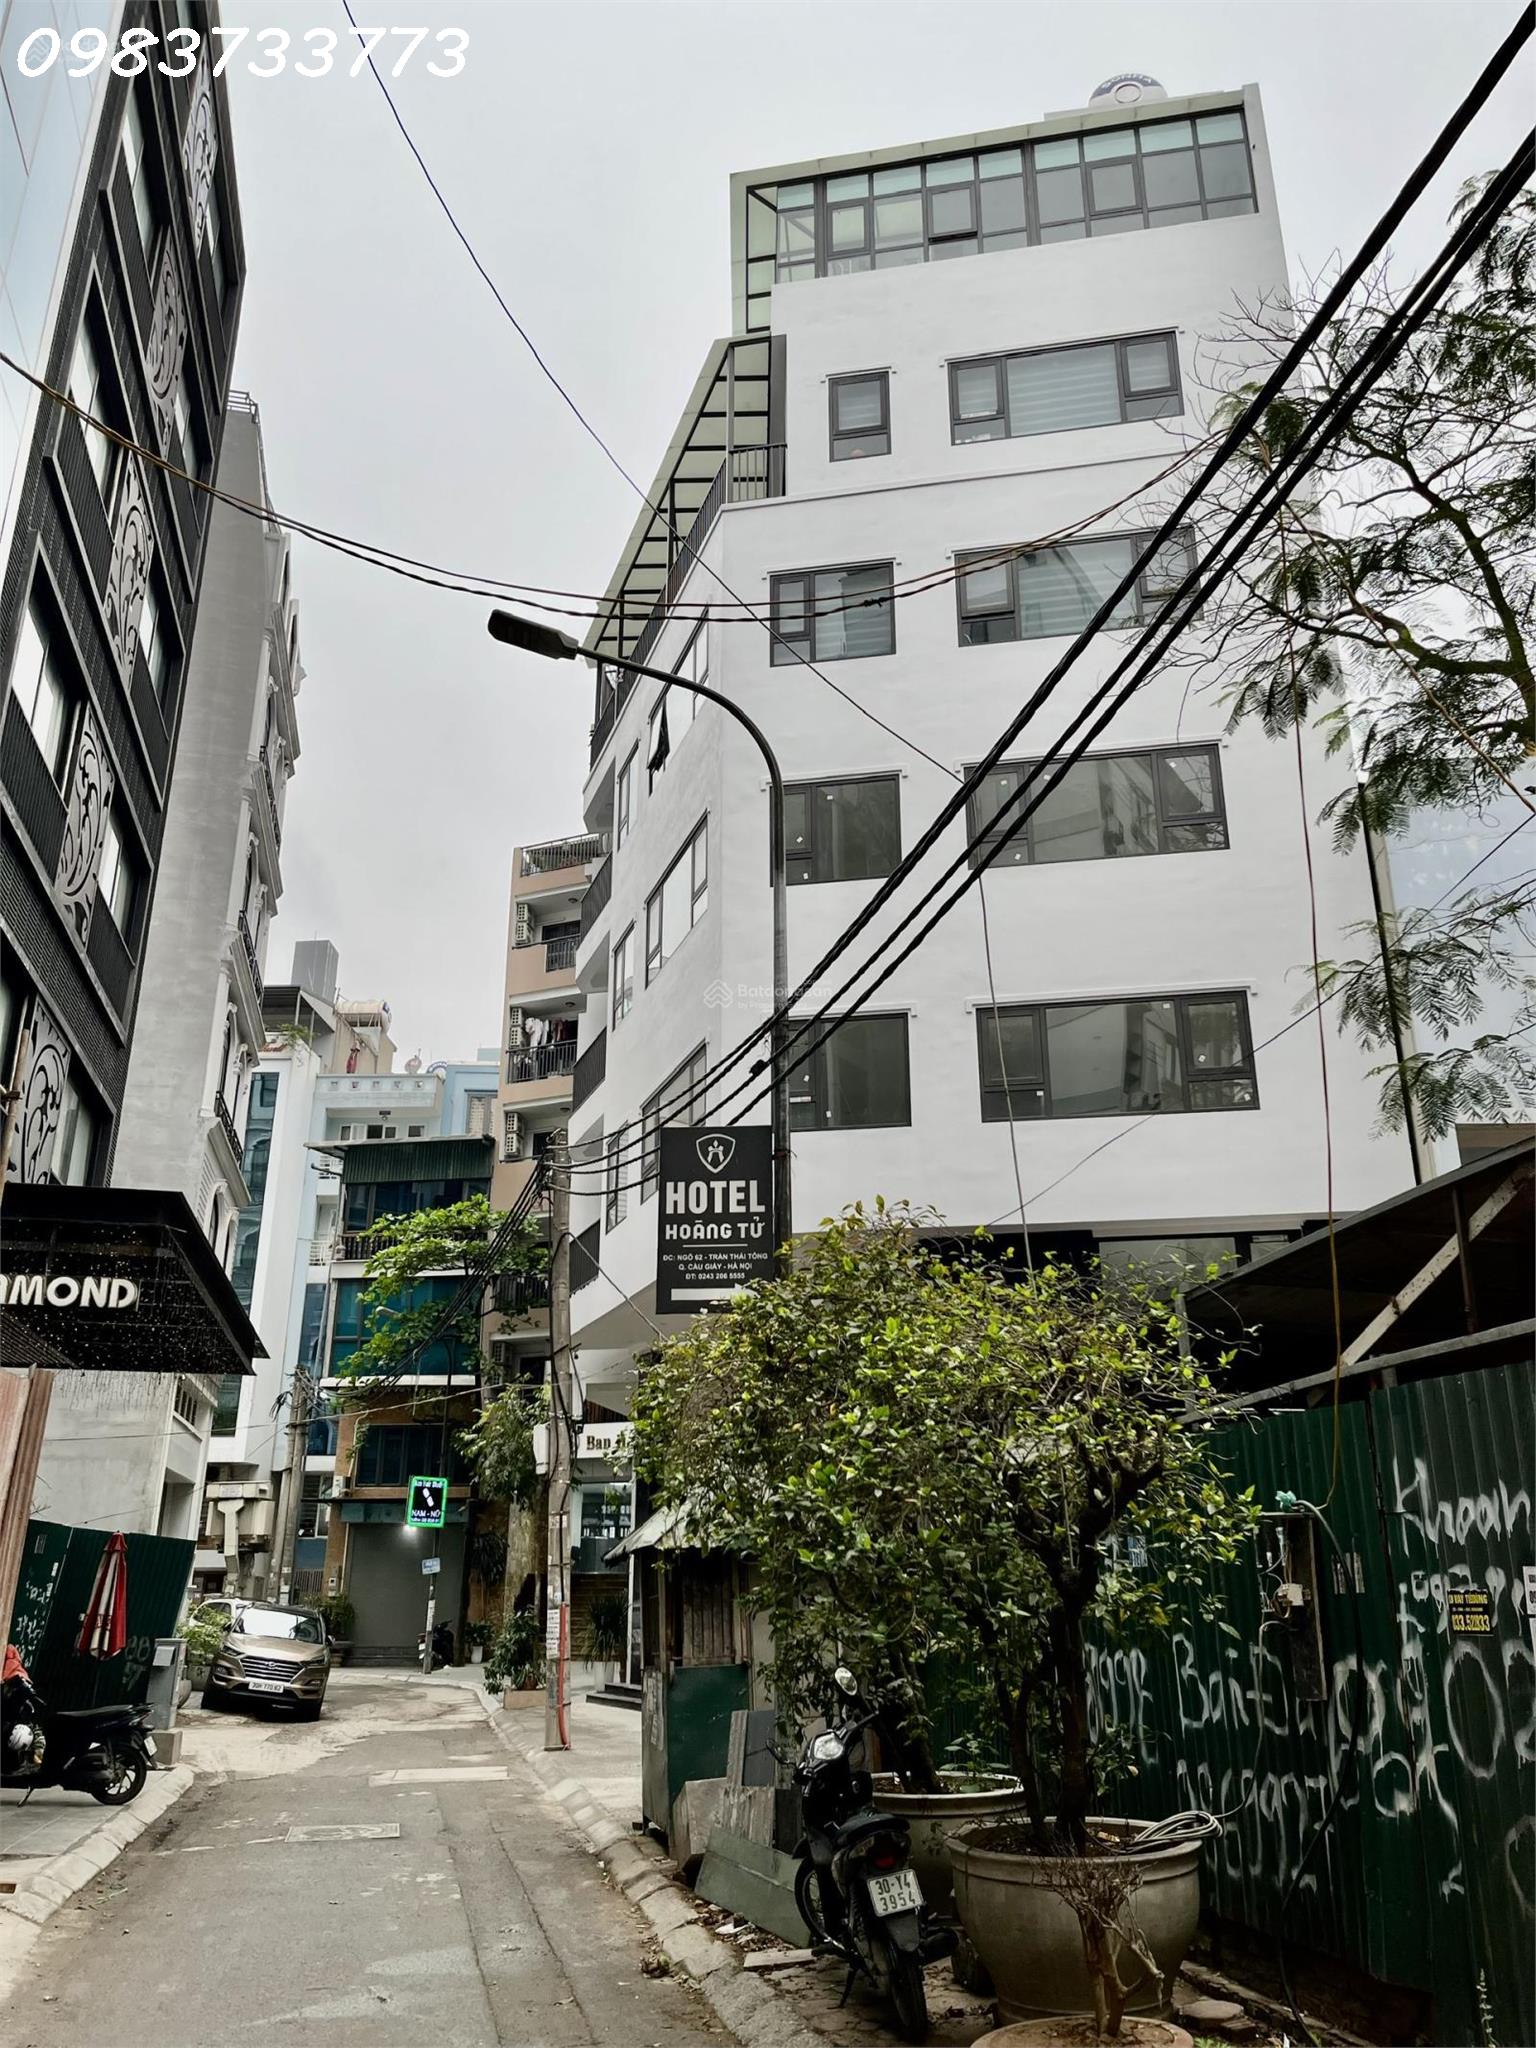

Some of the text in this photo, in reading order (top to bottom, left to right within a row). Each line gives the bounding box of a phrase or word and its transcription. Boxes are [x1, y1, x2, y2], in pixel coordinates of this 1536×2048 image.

[665, 1180, 766, 1214] HOTEL
[737, 1216, 765, 1239] TỬ
[875, 1874, 911, 1895] 30-Y4
[880, 1891, 915, 1912] 3954
